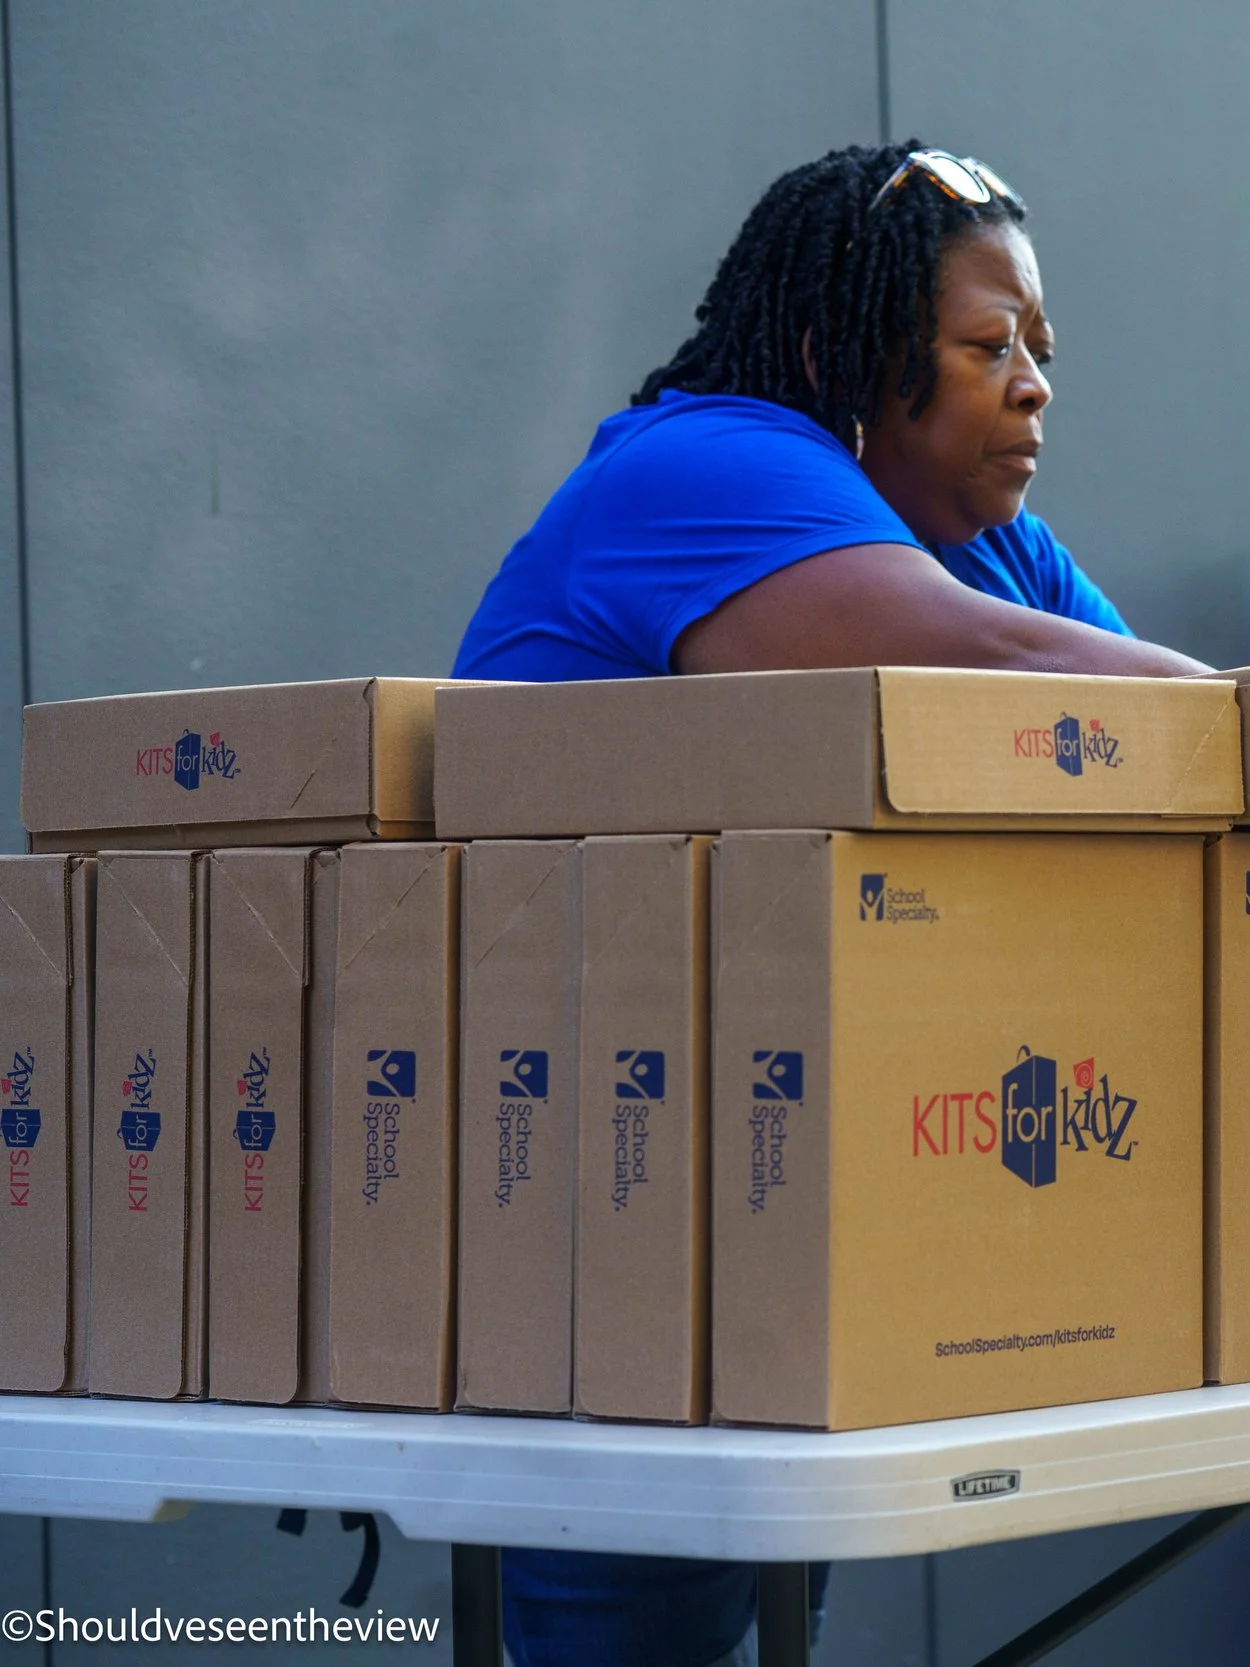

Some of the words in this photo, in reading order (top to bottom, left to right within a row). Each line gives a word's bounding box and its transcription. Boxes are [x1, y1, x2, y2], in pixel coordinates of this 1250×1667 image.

[136, 747, 174, 775] KITS
[177, 745, 199, 771] for
[1014, 729, 1054, 758] KITS
[1056, 728, 1079, 756] for
[887, 887, 926, 904] School
[8, 1112, 28, 1145] for
[128, 1114, 148, 1147] for
[243, 1114, 263, 1147] for
[384, 1102, 400, 1180] School
[515, 1103, 533, 1181] School
[632, 1105, 649, 1183] School
[770, 1105, 787, 1186] School
[913, 1090, 997, 1157] KITS
[1006, 1082, 1053, 1143] for
[9, 1150, 30, 1207] KITS
[128, 1154, 148, 1212] KITS
[244, 1153, 264, 1212] KITS
[935, 1325, 1116, 1358] SchoolSpecialty.com/kitsforkidz
